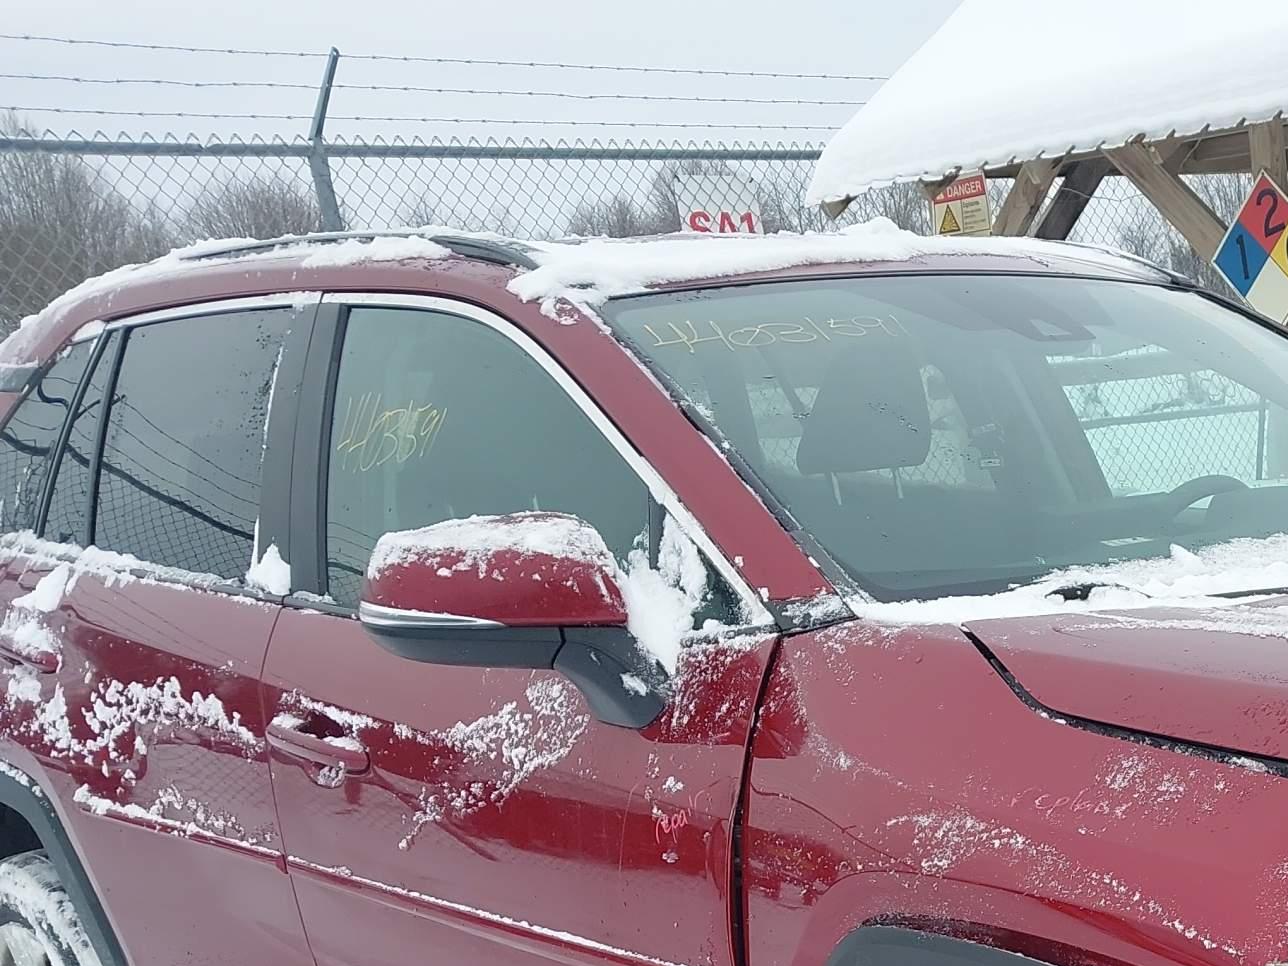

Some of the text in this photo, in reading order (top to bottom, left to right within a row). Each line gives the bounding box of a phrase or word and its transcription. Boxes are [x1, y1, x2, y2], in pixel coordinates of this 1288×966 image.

[946, 181, 982, 198] DANGER
[1256, 188, 1286, 238] 2
[1236, 234, 1249, 280] 1
